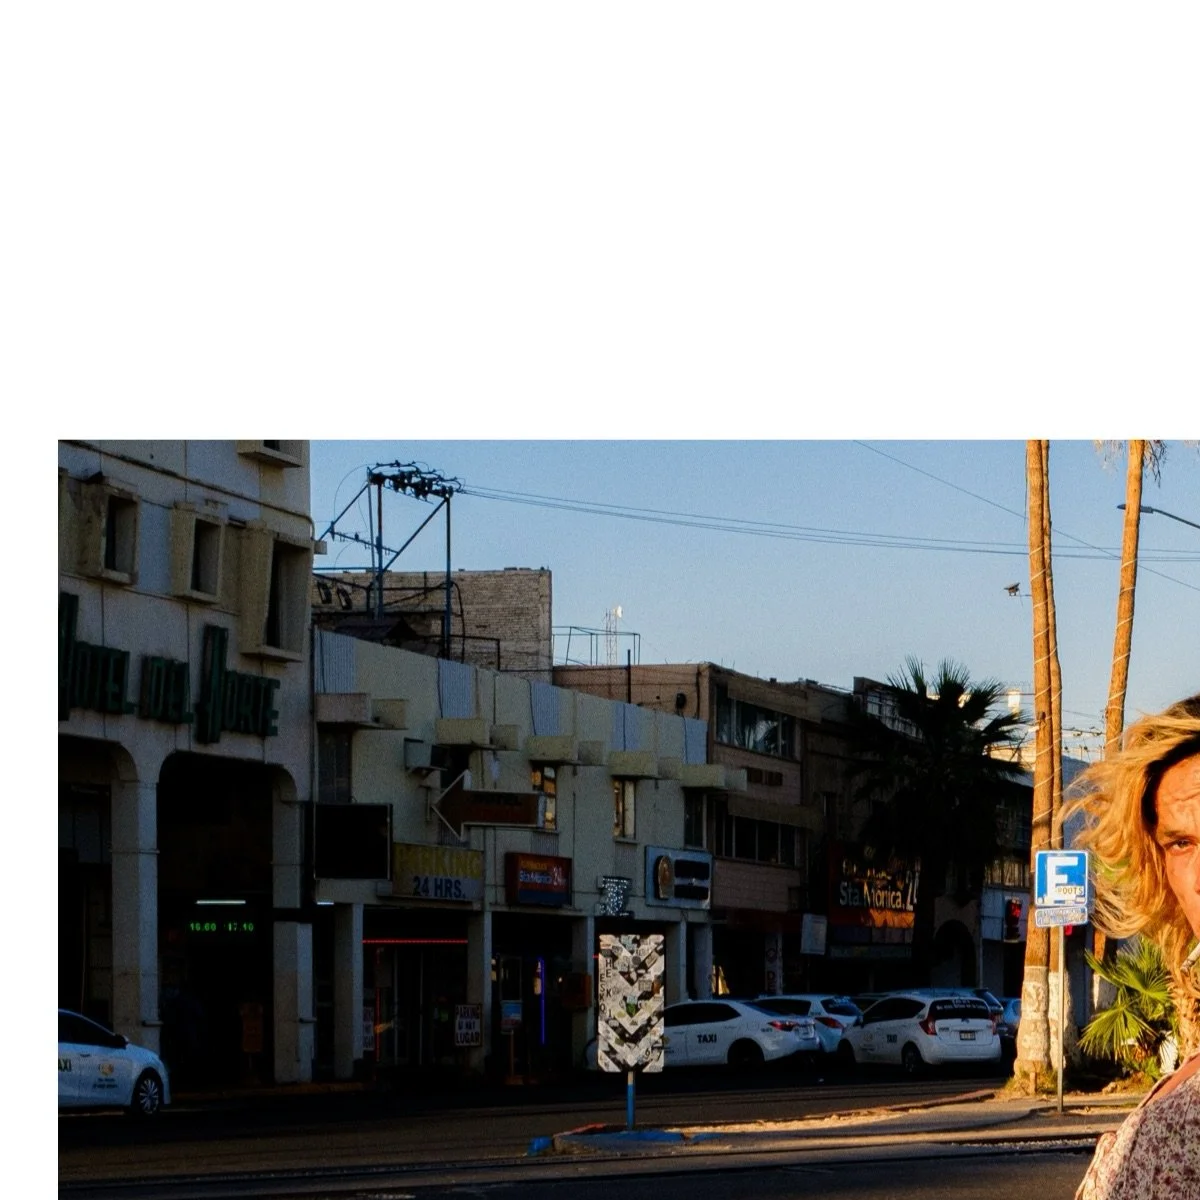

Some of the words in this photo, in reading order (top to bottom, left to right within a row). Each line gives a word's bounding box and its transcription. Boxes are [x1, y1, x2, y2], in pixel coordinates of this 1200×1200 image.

[413, 876, 429, 897] 24
[434, 878, 465, 898] HRS.
[697, 1034, 717, 1043] TAXI
